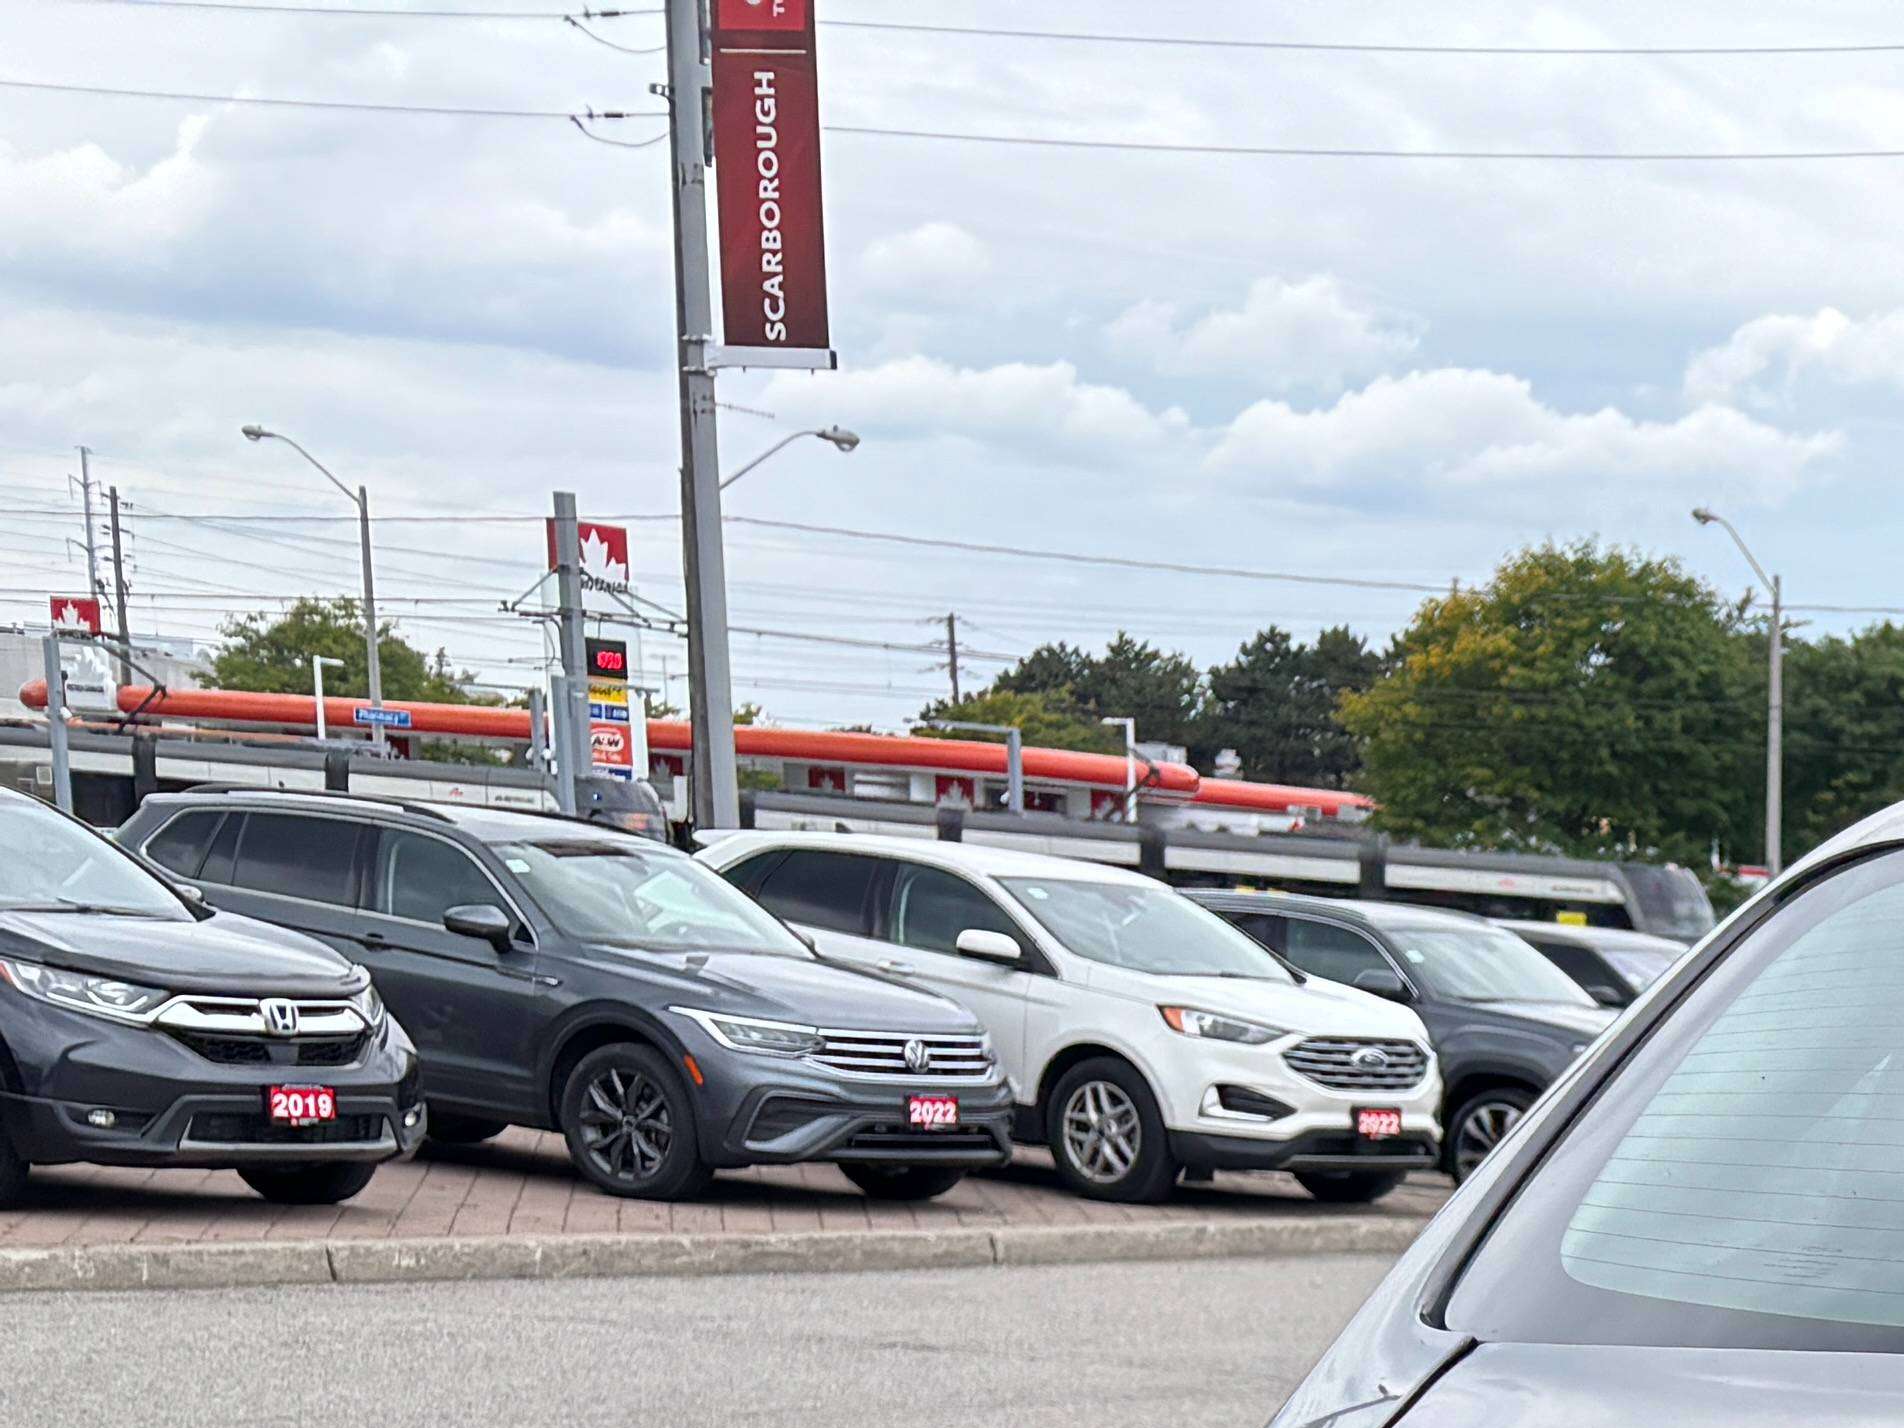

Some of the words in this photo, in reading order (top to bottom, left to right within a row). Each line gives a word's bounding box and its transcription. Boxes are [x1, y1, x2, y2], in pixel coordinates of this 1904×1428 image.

[754, 71, 787, 341] SCARBOROUGH
[272, 1093, 333, 1118] 2019
[910, 1100, 957, 1124] 2022
